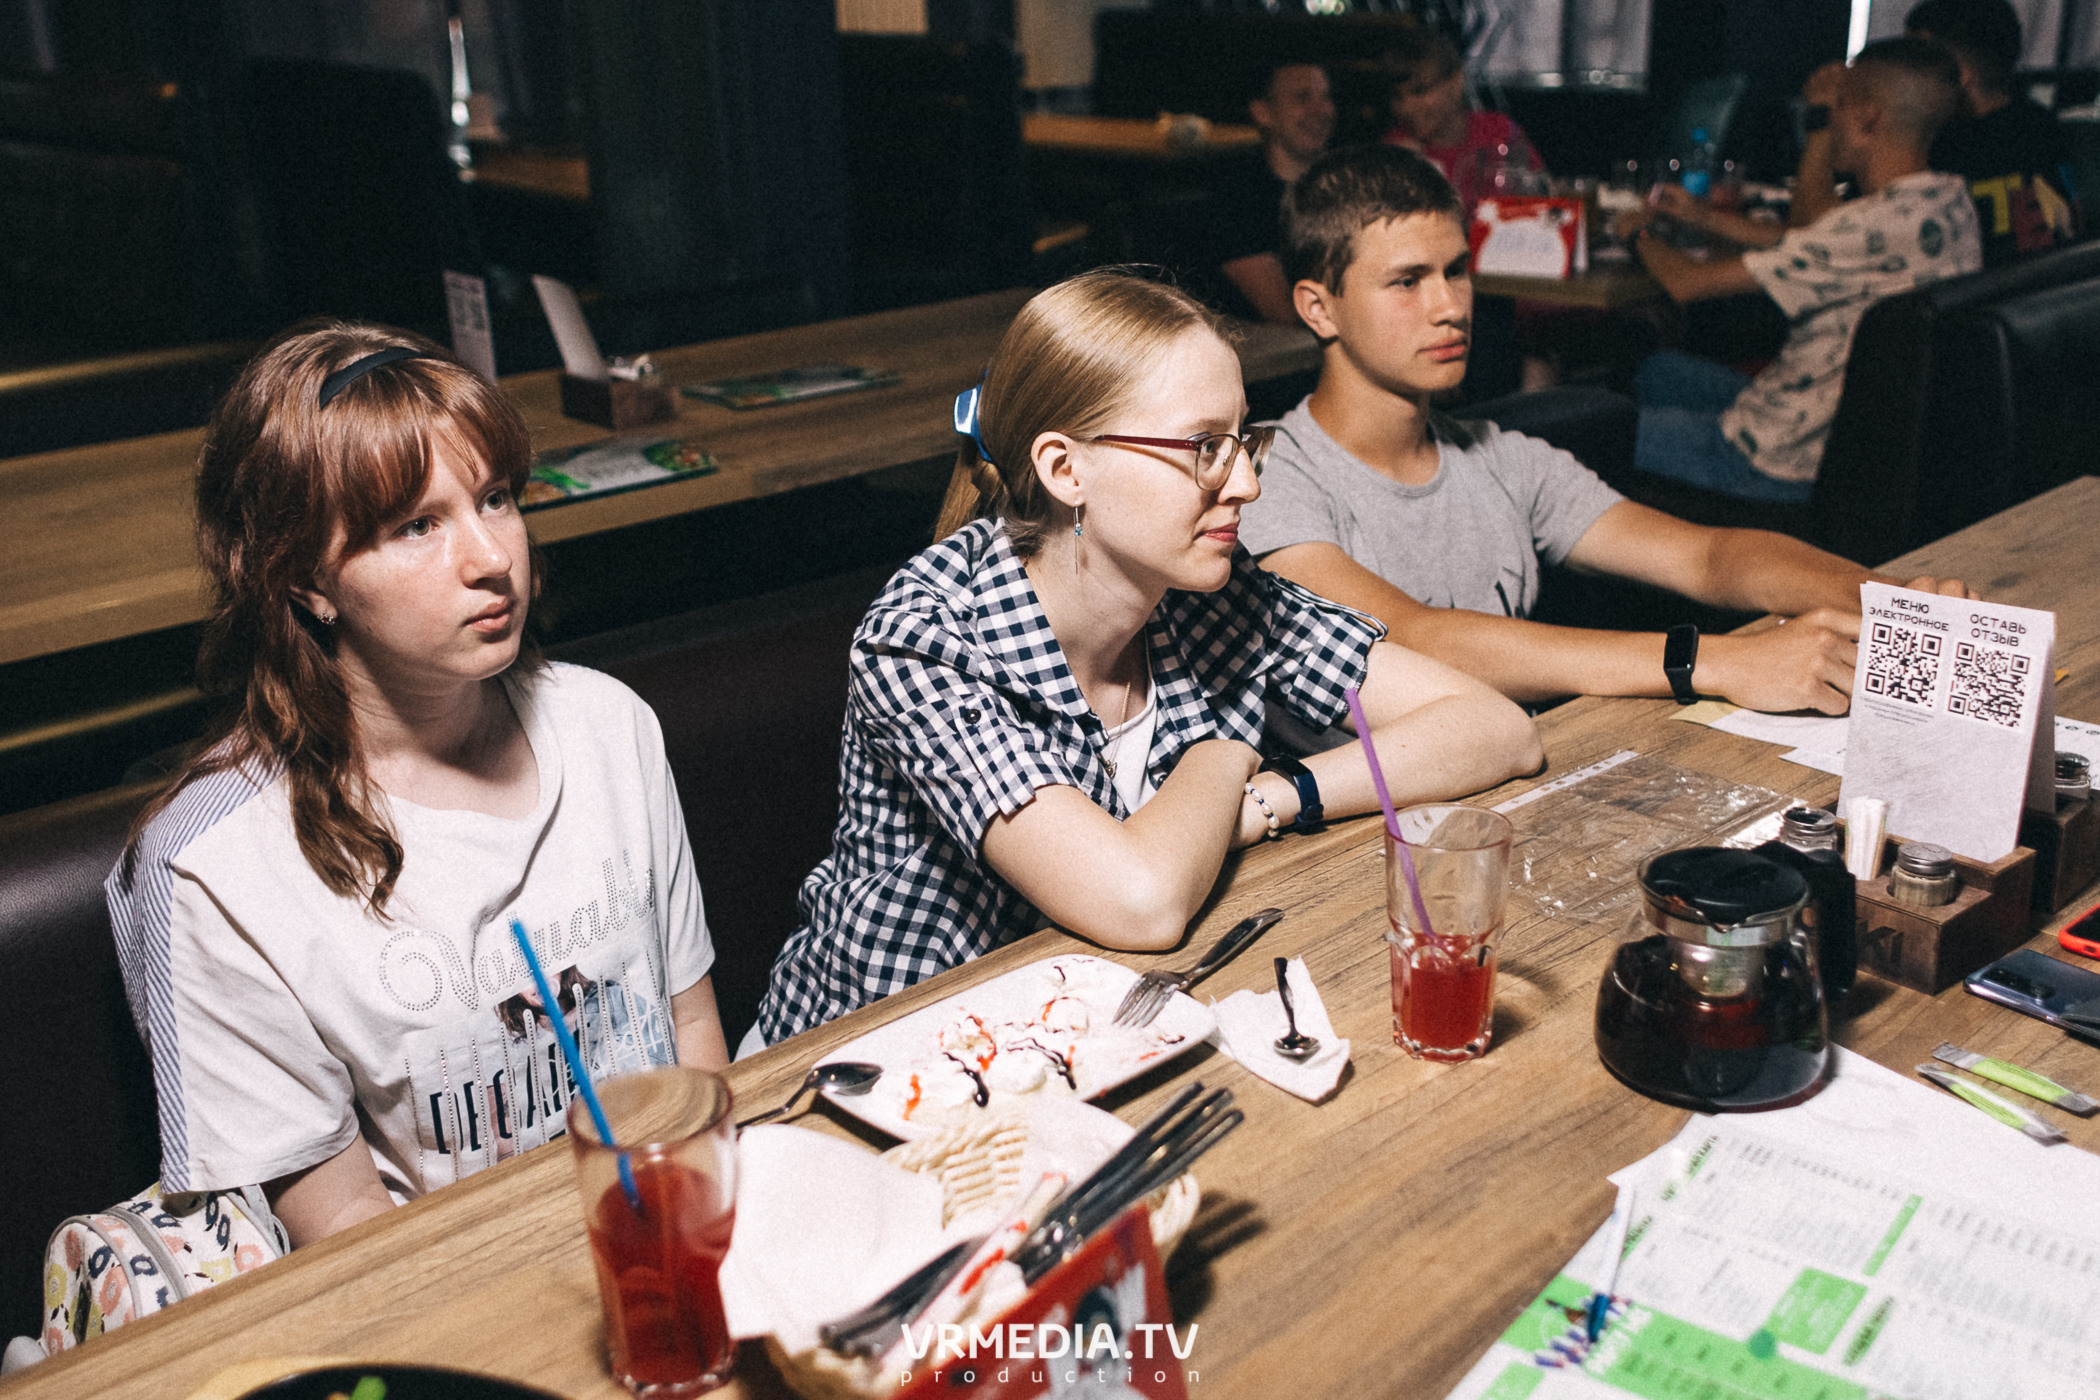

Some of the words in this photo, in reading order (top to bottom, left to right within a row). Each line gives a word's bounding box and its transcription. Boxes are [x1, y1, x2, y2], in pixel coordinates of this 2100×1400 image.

[1890, 597, 1930, 614] МЕНЮ
[1869, 607, 1950, 632] ЭЛЕКТРОННОЕ
[1969, 613, 2027, 635] ОСТАВЬ
[1970, 628, 2020, 647] ОТЗЫВ
